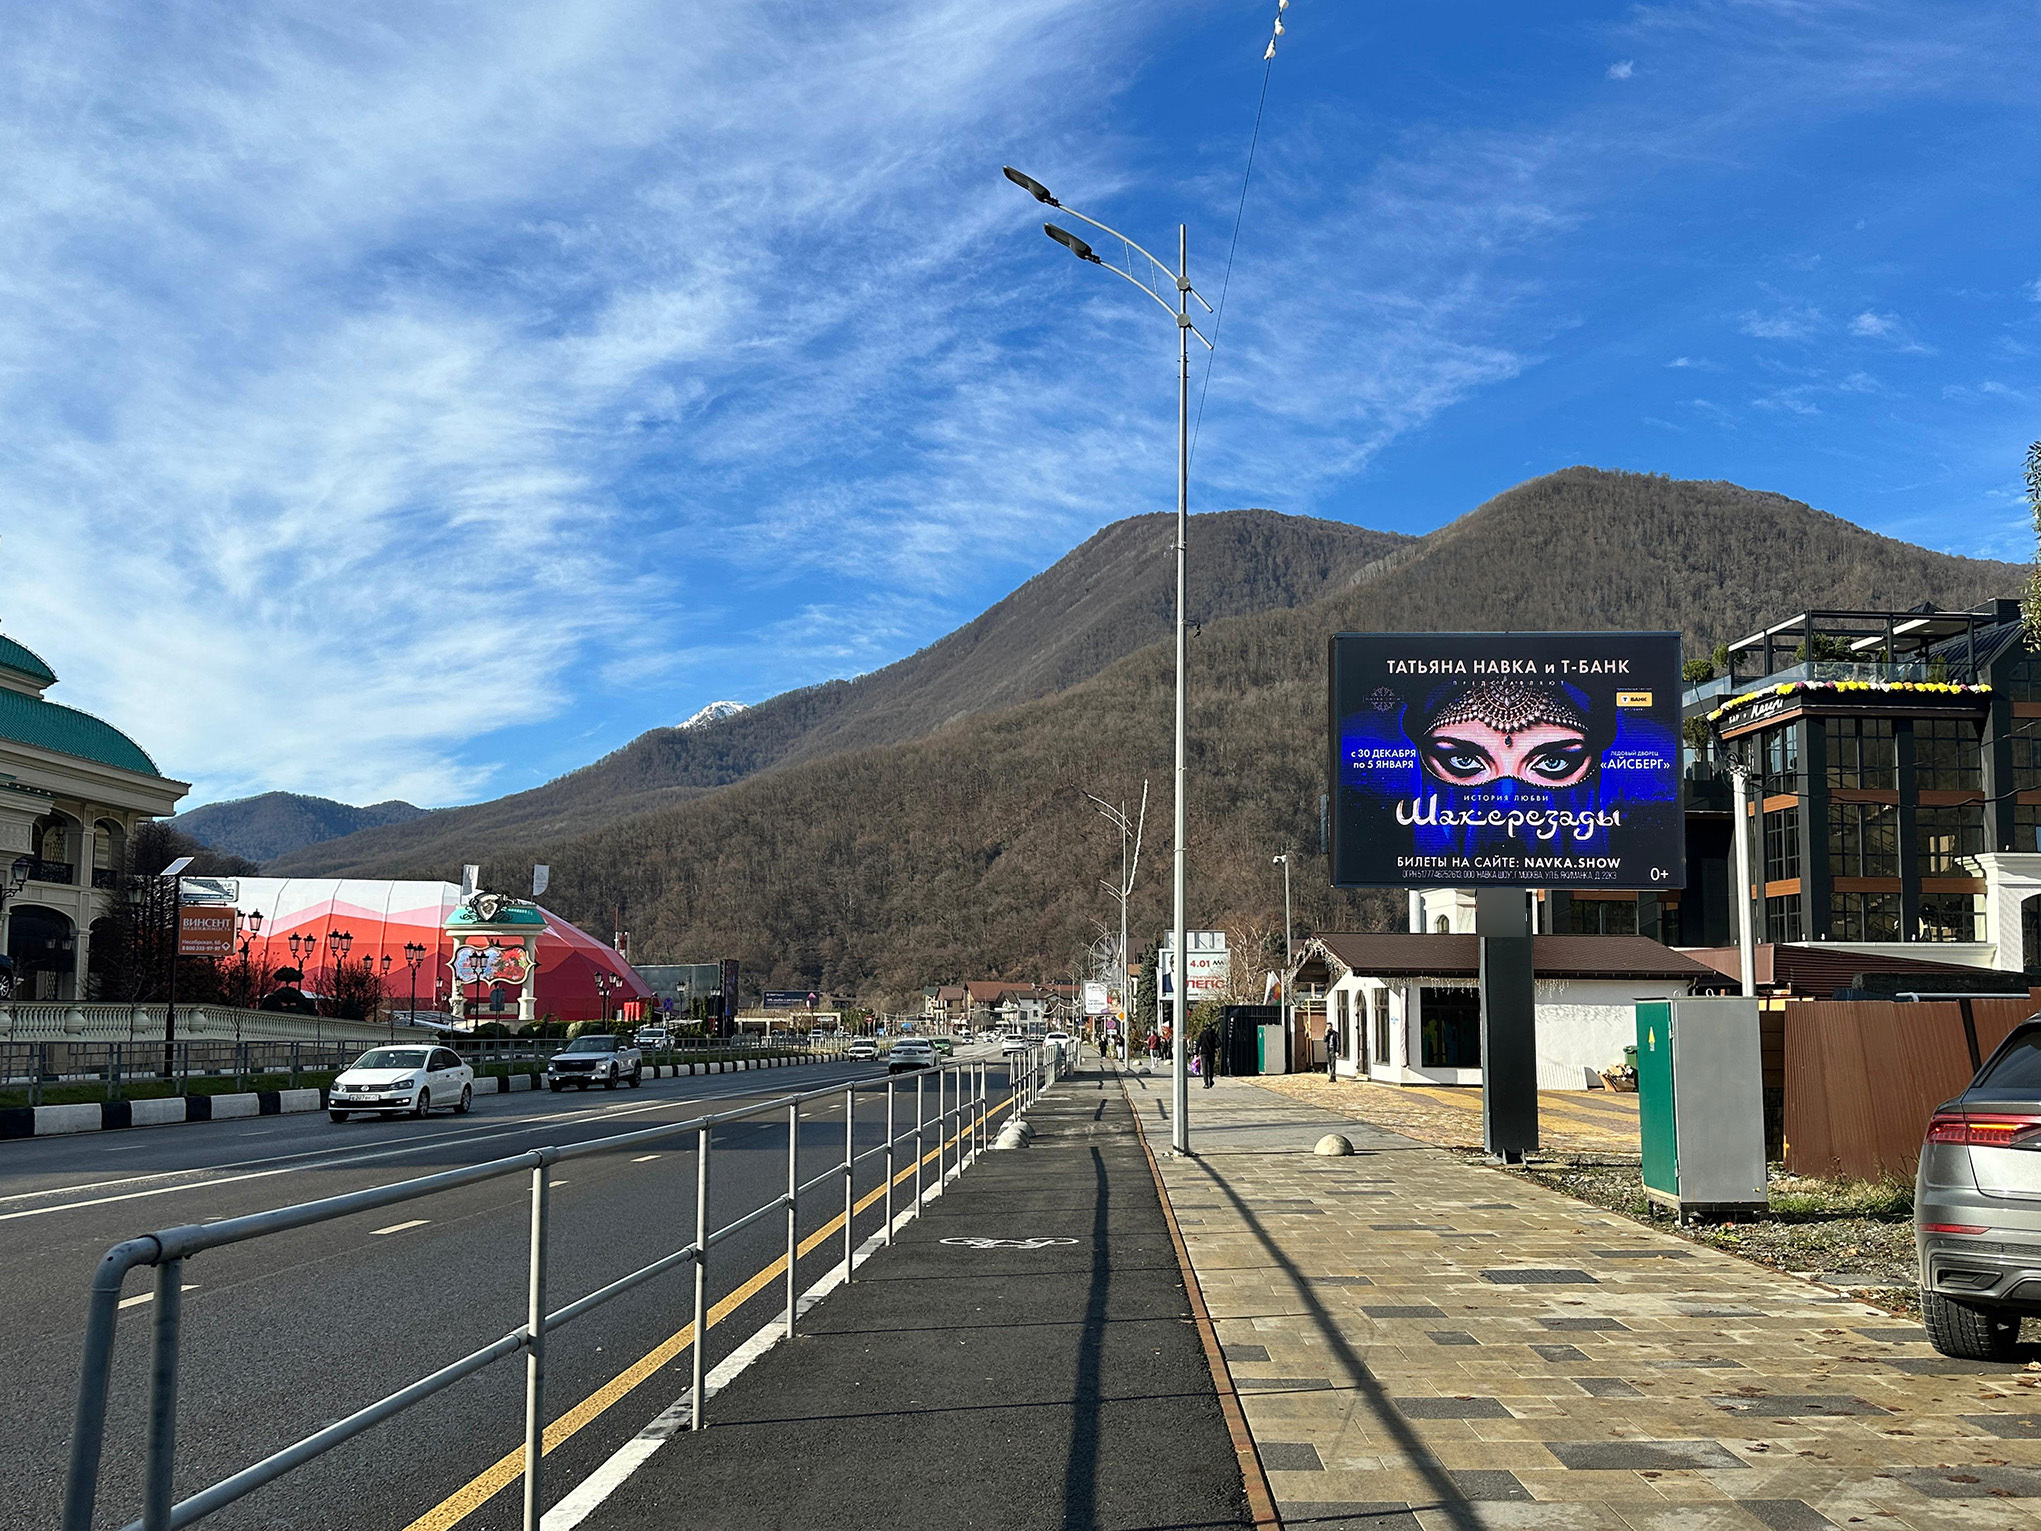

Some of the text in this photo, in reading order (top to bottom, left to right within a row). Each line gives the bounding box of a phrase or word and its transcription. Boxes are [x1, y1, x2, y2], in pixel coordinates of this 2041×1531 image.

[1386, 659, 1630, 674] ТАТЬЯНА НАВКА и Т-БАНК
[1357, 749, 1371, 758] 30
[1371, 749, 1416, 759] ДЕКАБРЯ
[1367, 760, 1374, 769] 5
[1375, 760, 1414, 769] ЯНВАРЯ
[1600, 756, 1671, 769] «АЙСБЕРГ»
[1463, 794, 1549, 802] ИСТОРИЯ ЛЮБВИ
[1395, 793, 1621, 840] Шахерезады
[1397, 854, 1621, 869] БИЛЕТЫ НА САЙТЕ: NAVKA.SHOW
[1649, 867, 1669, 881] 0+
[183, 918, 232, 927] ВИНСЕНТ
[1190, 960, 1210, 968] 4.01
[1186, 980, 1226, 989] ЛЕПС
